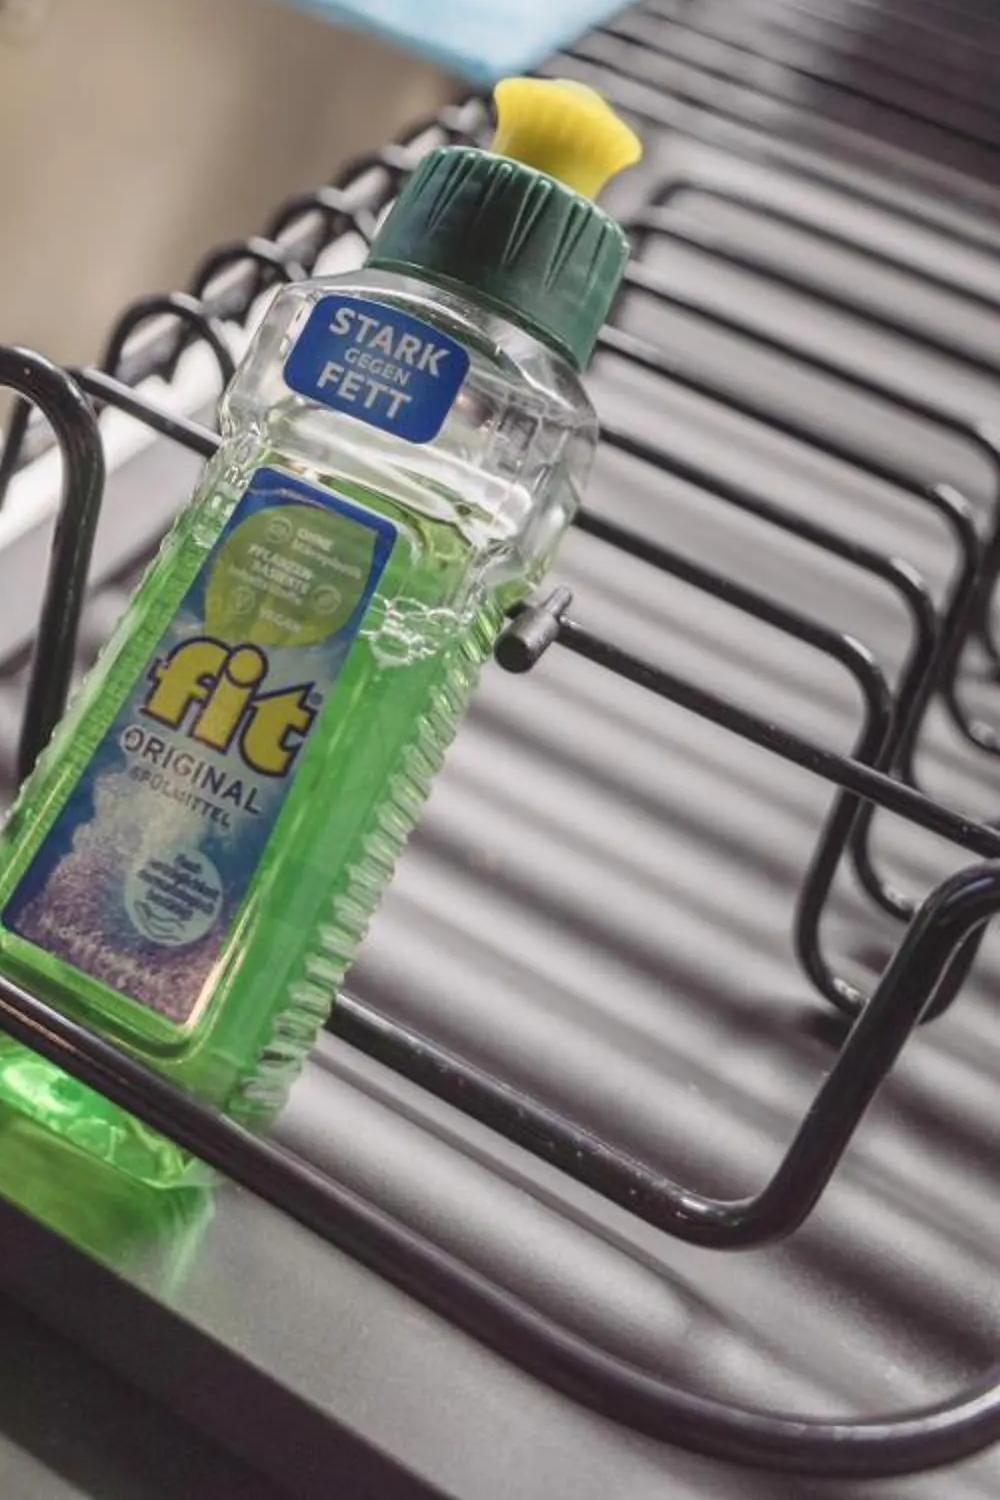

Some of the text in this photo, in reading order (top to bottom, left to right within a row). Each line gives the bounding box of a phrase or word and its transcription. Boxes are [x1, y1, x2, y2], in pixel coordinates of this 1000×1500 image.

[329, 307, 450, 378] STARK
[344, 348, 411, 387] GEGEN
[316, 361, 412, 419] FETT
[140, 636, 318, 779] fit
[123, 727, 261, 815] ORIGINAL
